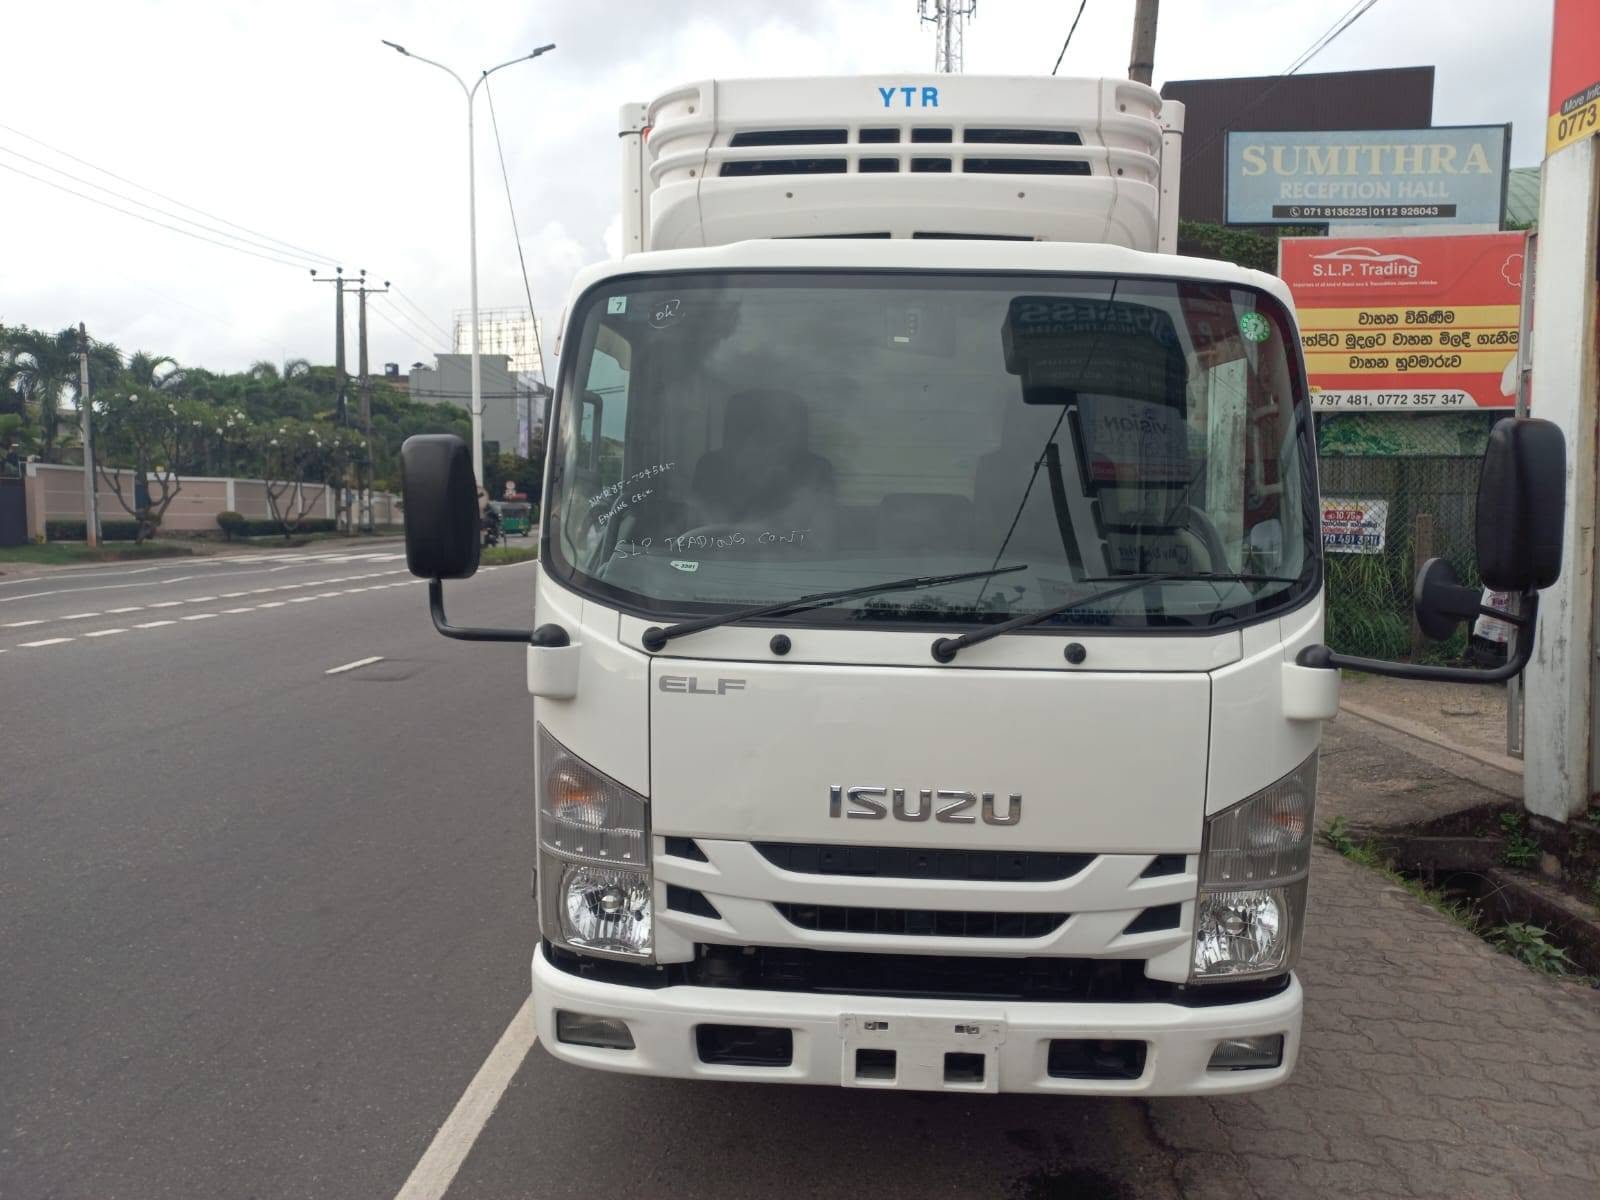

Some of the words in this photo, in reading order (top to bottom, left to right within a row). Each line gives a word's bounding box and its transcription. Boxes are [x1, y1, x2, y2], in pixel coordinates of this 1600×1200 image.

[878, 87, 938, 107] YTR
[1558, 103, 1597, 141] 0773
[1241, 143, 1492, 177] SUMITHRA
[1280, 181, 1390, 199] RECEPTION
[1399, 181, 1448, 198] HALL
[1303, 206, 1321, 216] 071
[1400, 206, 1438, 216] 926043
[1312, 263, 1354, 276] S.L.P.
[1360, 262, 1418, 277] Trading
[615, 301, 623, 312] 7
[1358, 312, 1398, 325] වාහන
[1405, 310, 1454, 324] විකිණීම
[1346, 333, 1386, 349] මුදලට
[1393, 332, 1432, 346] වාහන
[1349, 356, 1389, 369] වාහන
[1319, 394, 1341, 405] 797
[1377, 394, 1408, 405] 0772
[1413, 394, 1436, 404] 357
[1441, 394, 1465, 404] 347
[659, 675, 746, 695] ELF
[829, 785, 1022, 826] ISUZU
